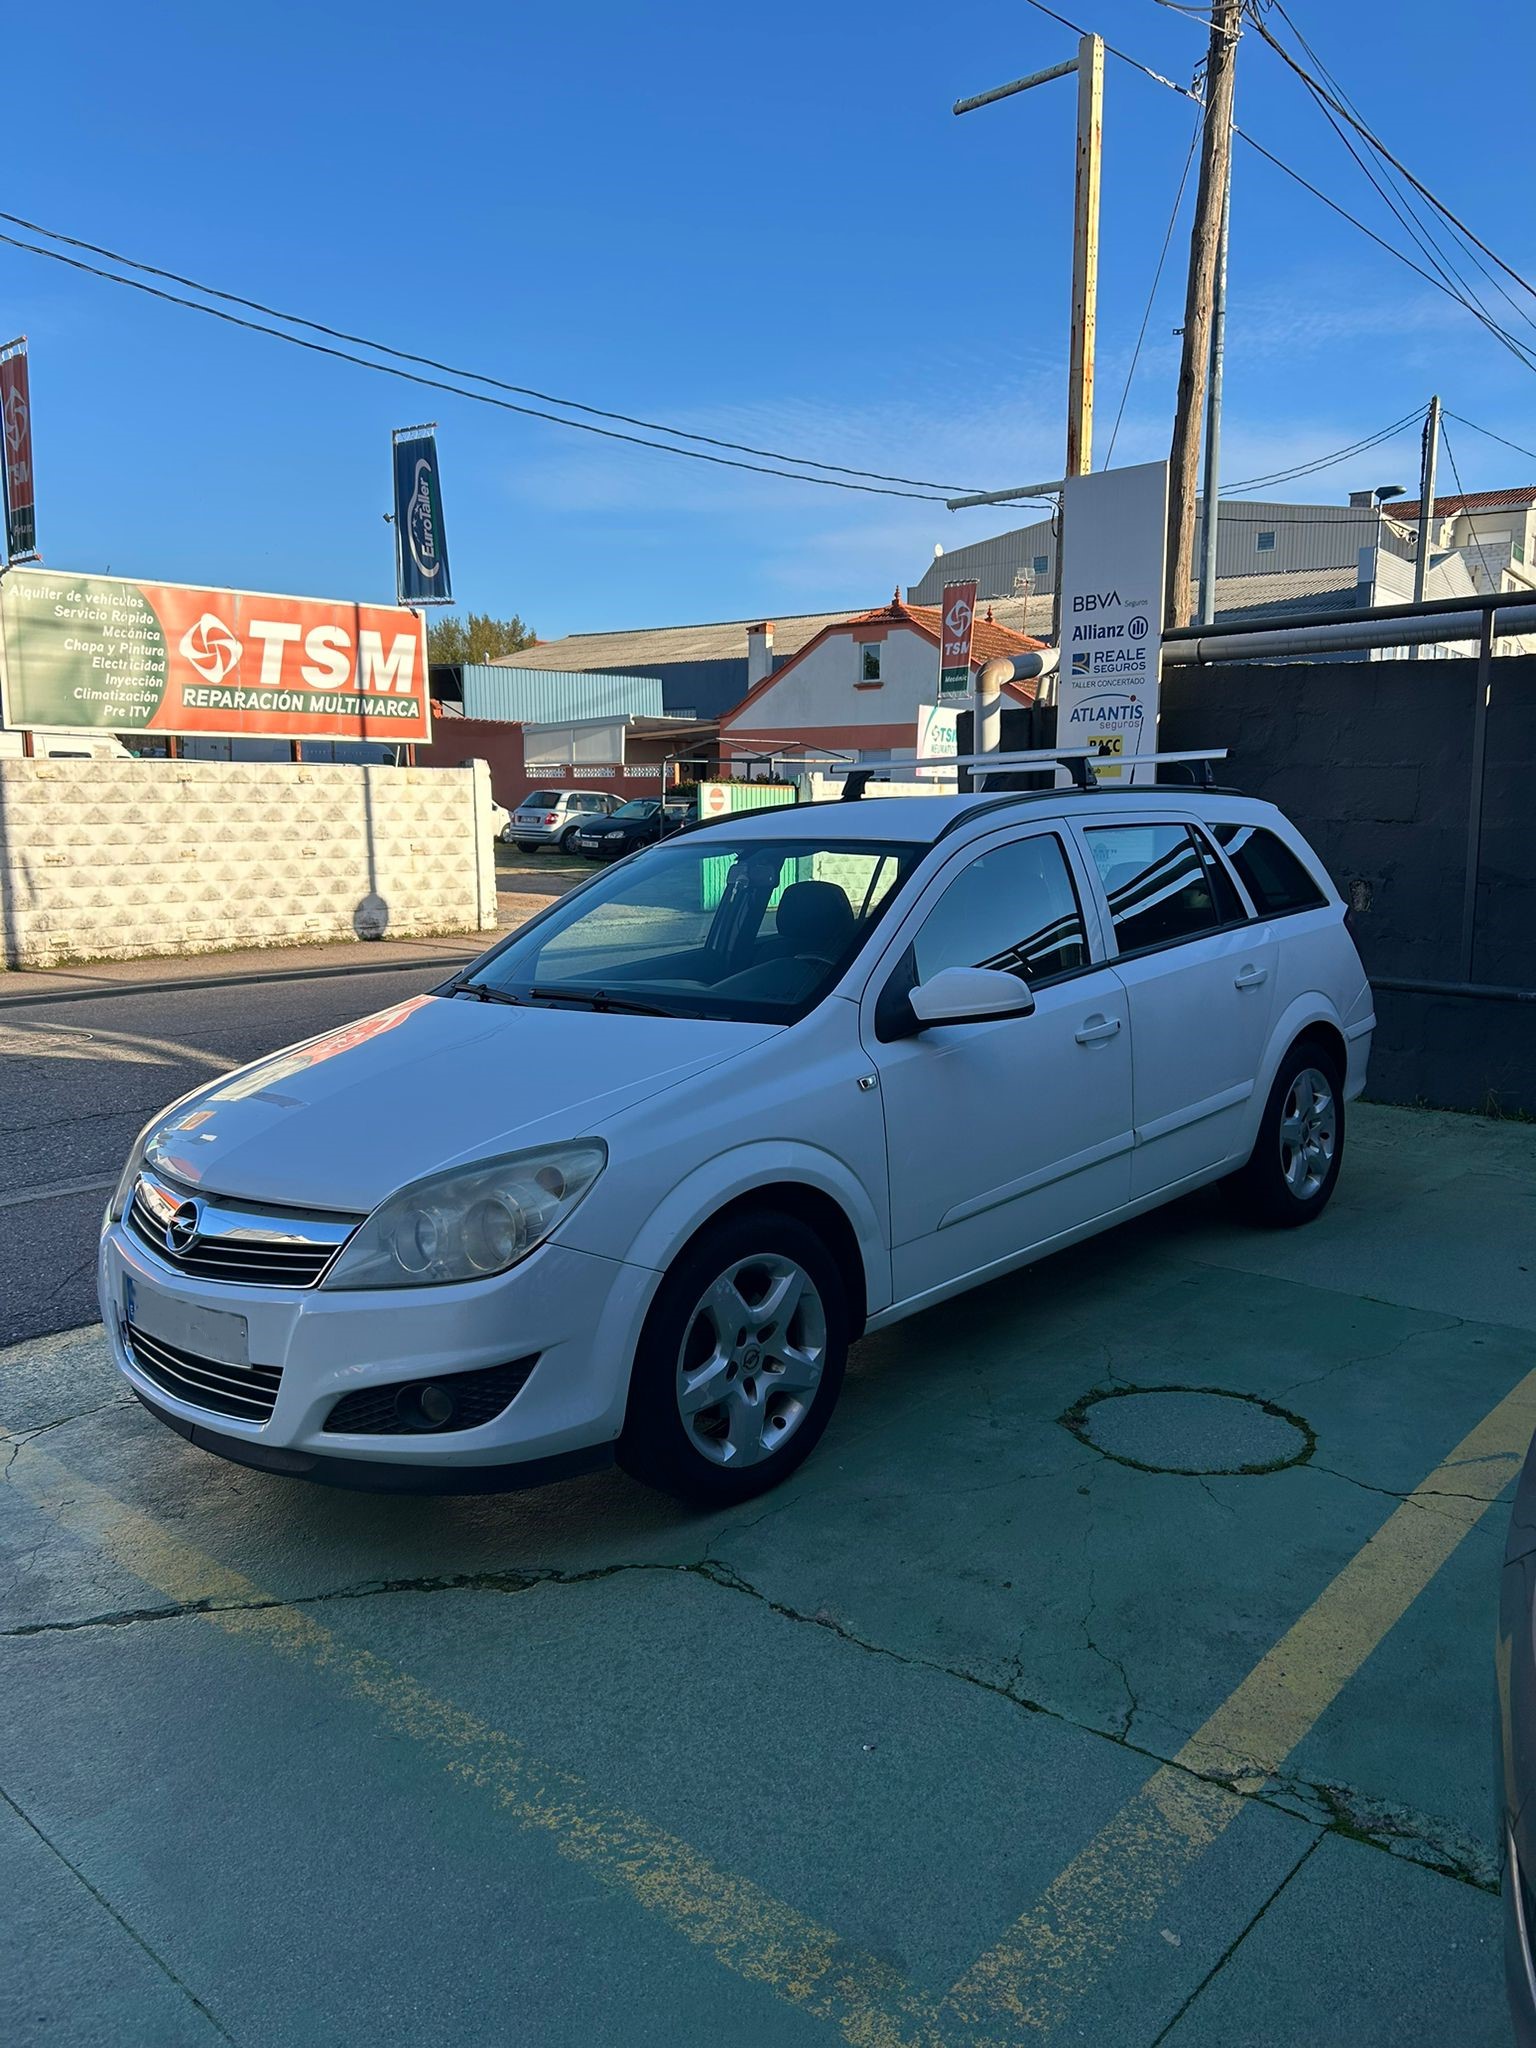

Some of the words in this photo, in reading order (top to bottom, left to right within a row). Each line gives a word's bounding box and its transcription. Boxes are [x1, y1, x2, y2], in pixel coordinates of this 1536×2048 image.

[420, 477, 435, 558] EuroTaller
[9, 584, 62, 601] Alquiler
[67, 590, 82, 602] de
[85, 592, 144, 608] vehículos
[1073, 590, 1121, 613] BBVA
[1124, 600, 1148, 608] Seguros
[54, 605, 108, 621] Servicio
[111, 611, 154, 625] Rápido
[102, 625, 161, 641] Mecánica
[1072, 623, 1125, 641] Allianz
[64, 639, 104, 655] Chapa
[108, 646, 117, 656] y
[119, 643, 165, 657] Pintura
[248, 619, 416, 693] TSM
[1094, 647, 1146, 664] REALE
[92, 656, 165, 672] Electricidad
[1093, 661, 1146, 674] SEGUROS
[105, 673, 163, 688] Inyección
[1072, 680, 1096, 689] TALLER
[1097, 677, 1145, 688] CONCERTADO
[73, 687, 158, 703] Climatización
[182, 688, 304, 712] REPARACIÓN
[309, 694, 419, 718] MULTIMARCA
[103, 704, 126, 717] Pre
[129, 705, 151, 717] ITV
[1070, 705, 1144, 722] ATLANTIS
[1099, 719, 1140, 731] seguros
